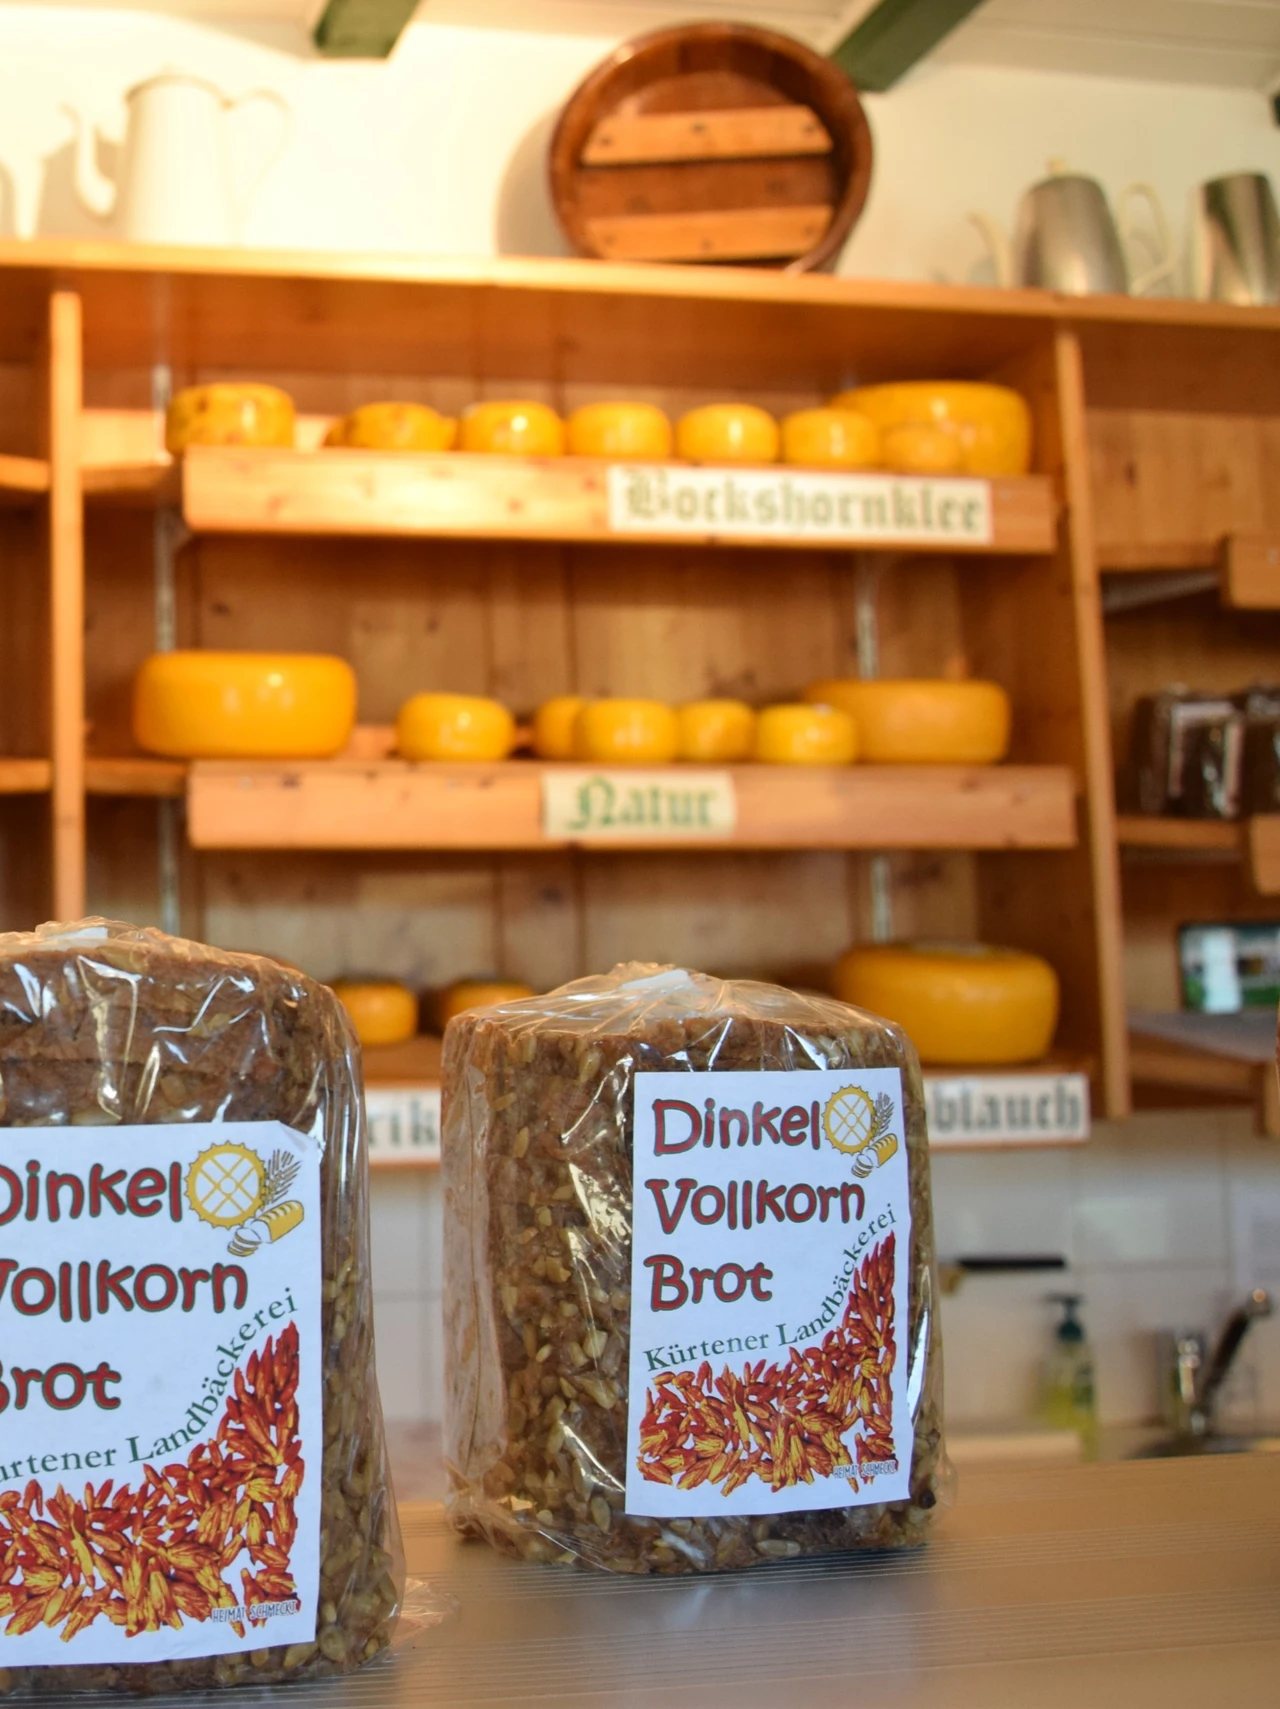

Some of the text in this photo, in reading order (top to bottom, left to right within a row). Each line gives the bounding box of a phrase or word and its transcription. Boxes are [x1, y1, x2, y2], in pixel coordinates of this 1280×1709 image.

[567, 774, 716, 830] Natur
[651, 1098, 820, 1156] Dinkel
[644, 1178, 866, 1235] Vollkorn
[643, 1254, 774, 1313] Brot
[643, 1203, 898, 1373] Kürtener Landbäckerei
[125, 1287, 298, 1464] Landbäckerei
[212, 1607, 246, 1622] HEIMAT
